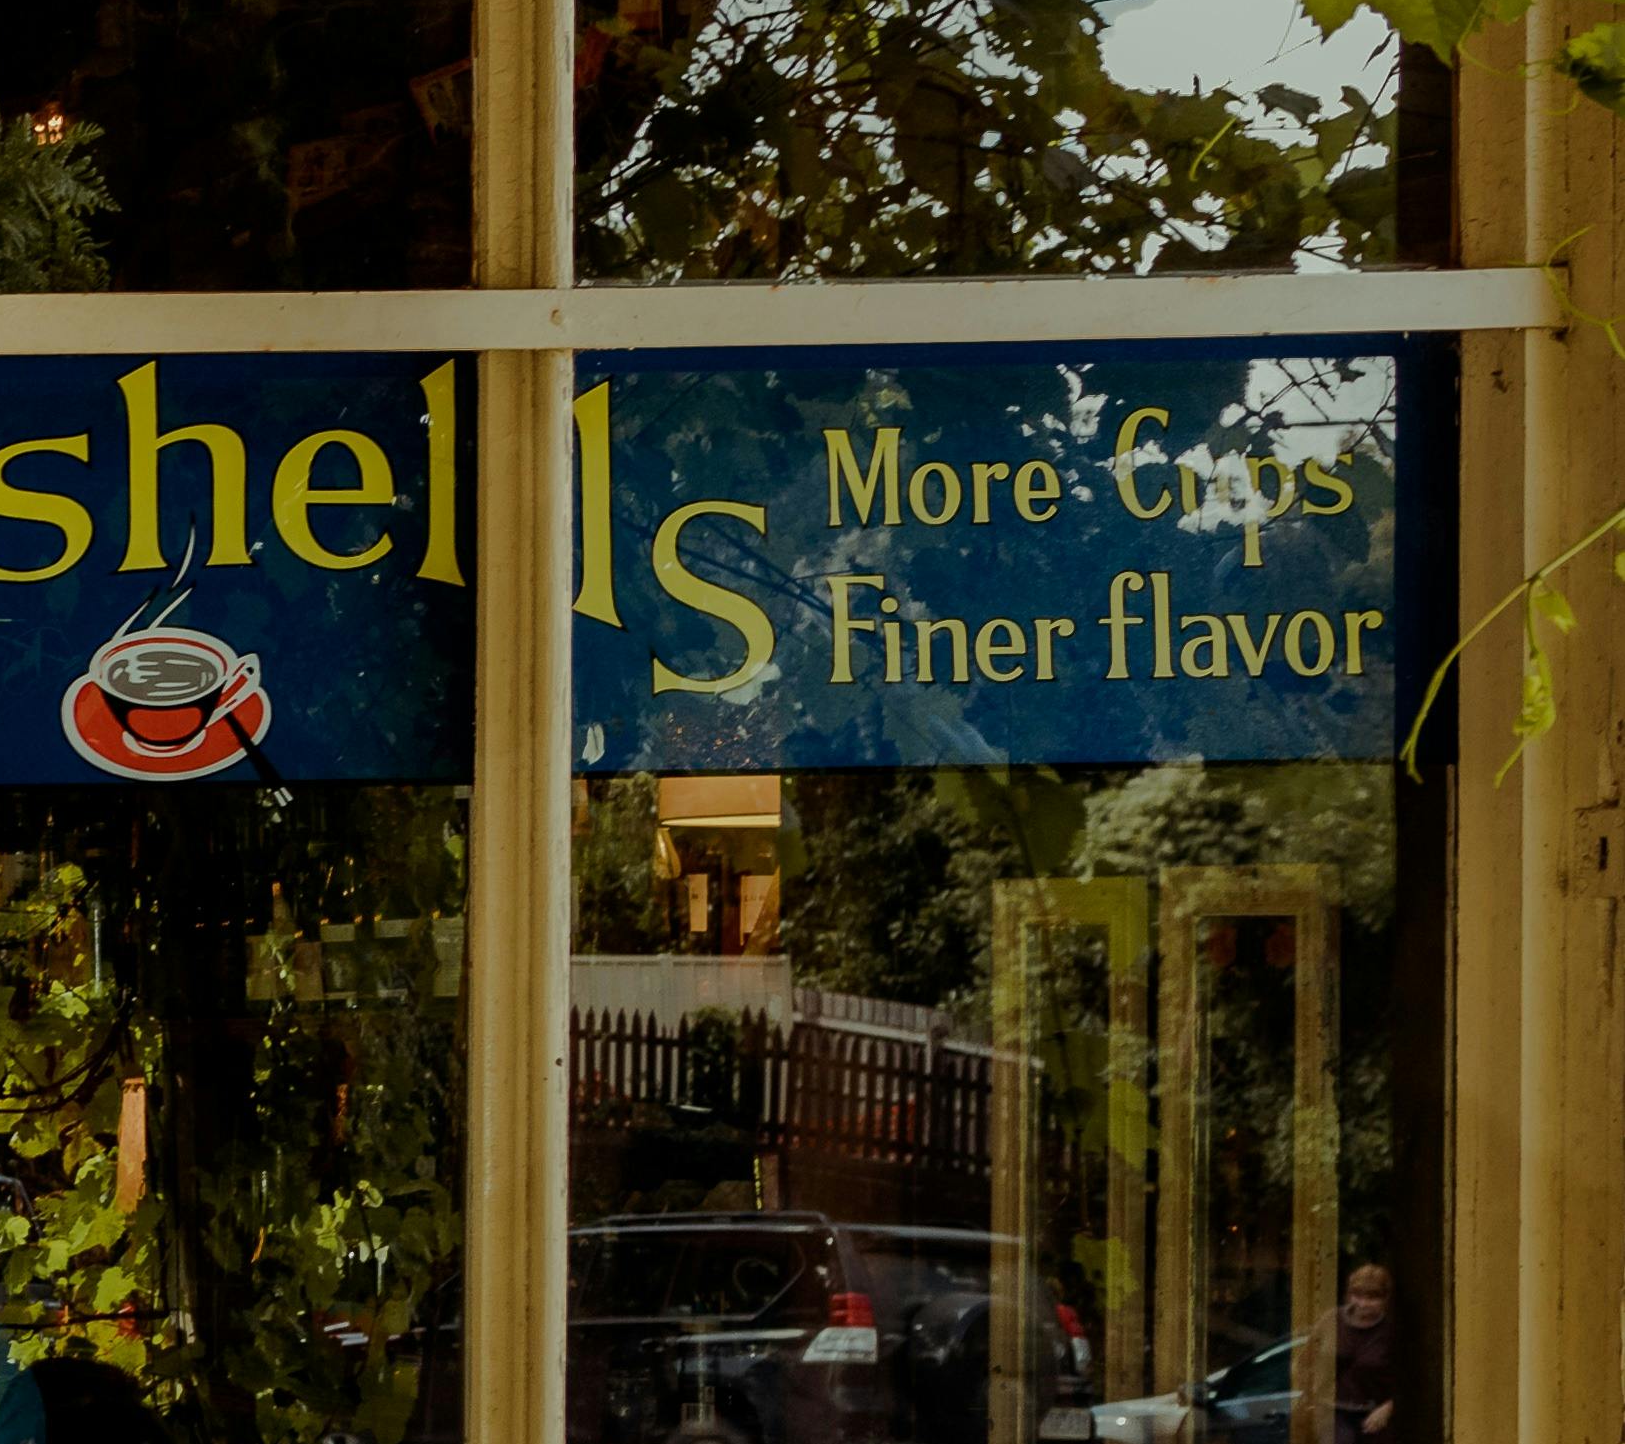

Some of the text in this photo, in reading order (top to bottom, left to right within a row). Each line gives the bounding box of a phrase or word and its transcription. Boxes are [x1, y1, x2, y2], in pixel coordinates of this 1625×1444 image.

[827, 427, 1061, 527] More
[830, 570, 1385, 684] Finer flavor
